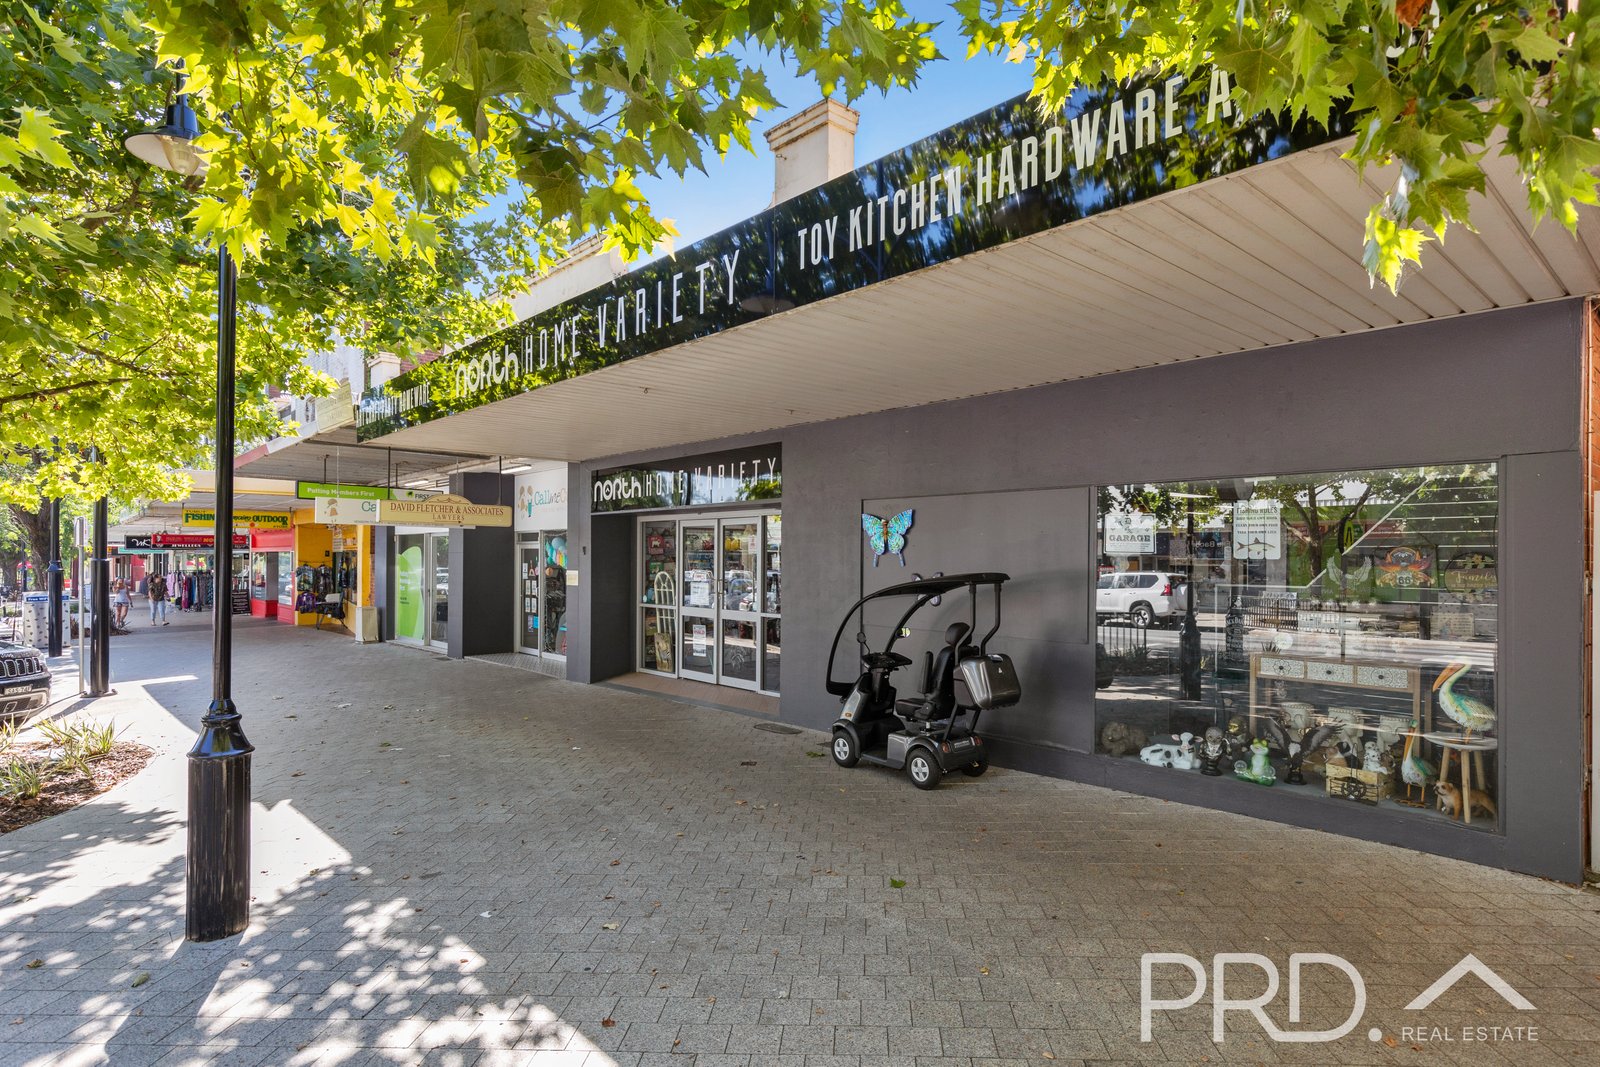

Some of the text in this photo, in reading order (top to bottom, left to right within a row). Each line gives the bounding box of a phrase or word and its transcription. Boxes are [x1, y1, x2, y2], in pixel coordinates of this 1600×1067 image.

[798, 215, 838, 270] TOY
[849, 165, 962, 252] KITCHEN
[976, 74, 1184, 206] HARDWARE
[524, 313, 582, 374] HOME
[597, 249, 741, 348] VARIETY
[646, 469, 684, 497] HOME
[694, 457, 777, 491] VARIETY
[307, 487, 330, 496] Putting
[331, 489, 359, 497] Members
[390, 502, 415, 512] DAVID
[416, 504, 454, 514] FLETCHER
[463, 507, 504, 516] ASSOCIATES
[185, 513, 215, 523] FISHIN
[252, 515, 288, 526] OUTDOOR
[1109, 534, 1151, 542] GARAGE
[1398, 575, 1411, 584] 66
